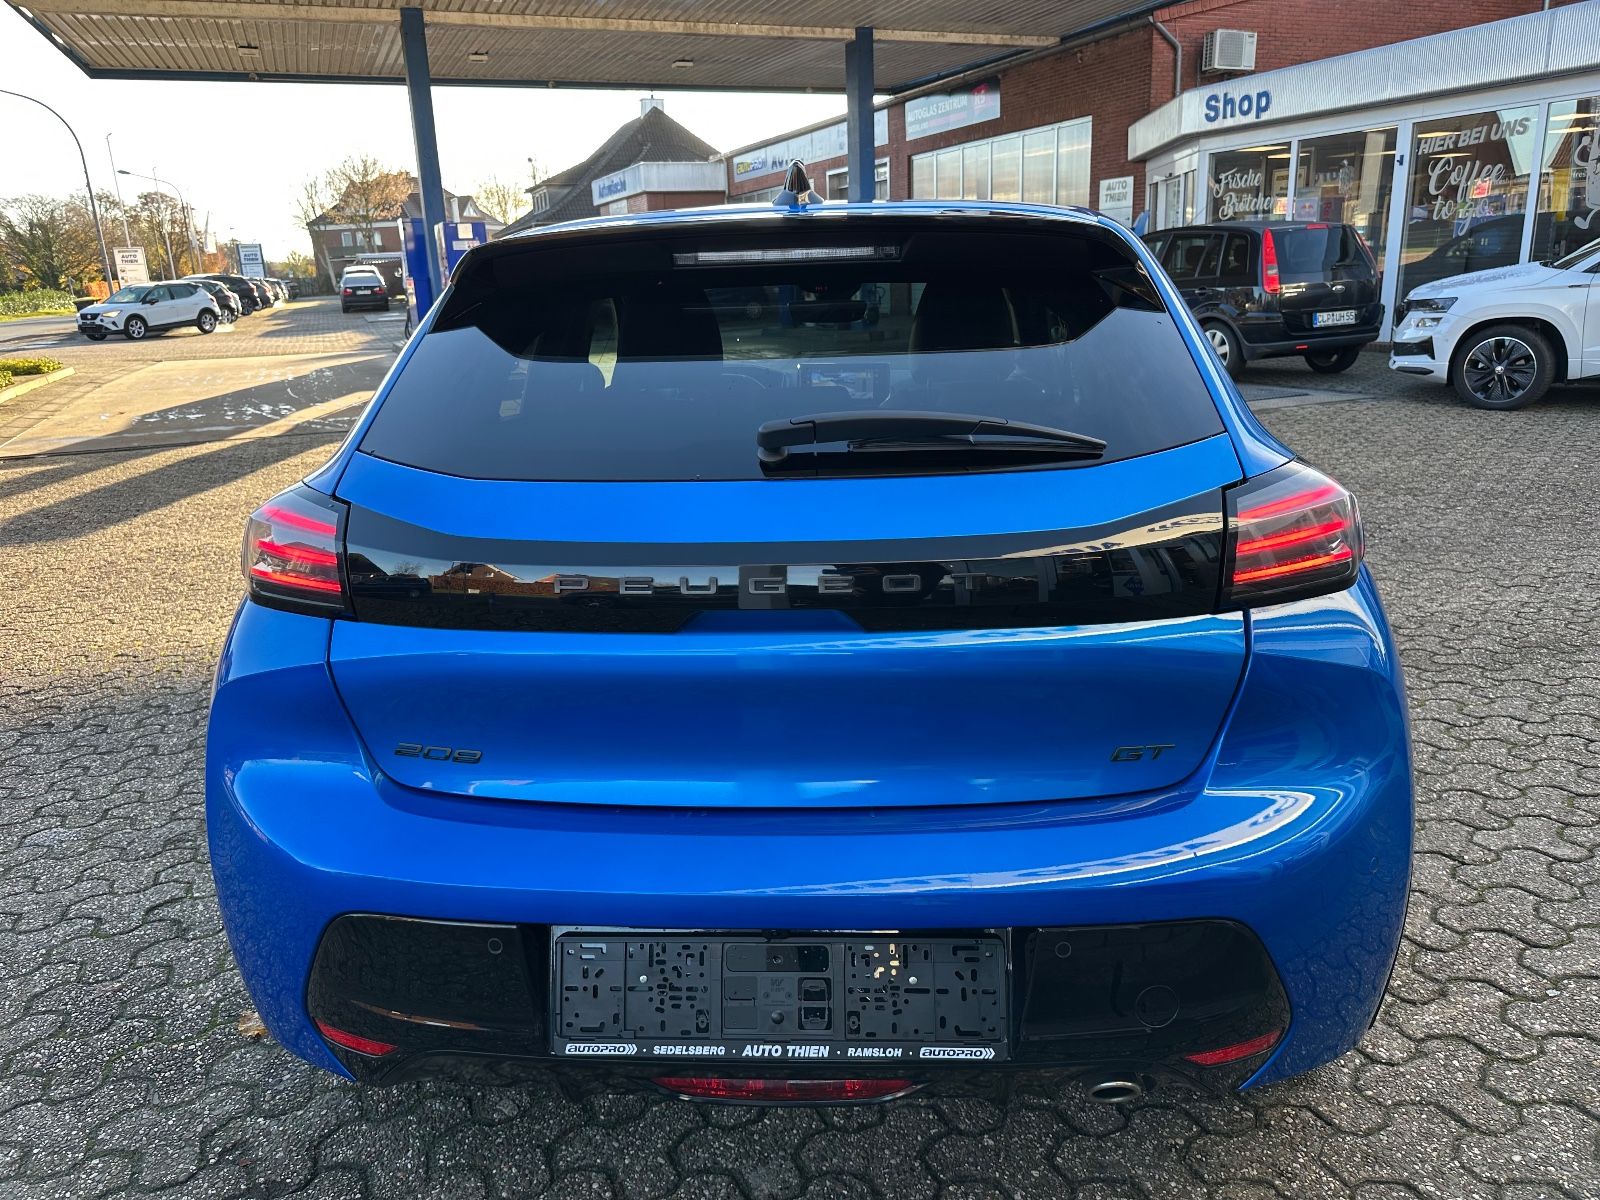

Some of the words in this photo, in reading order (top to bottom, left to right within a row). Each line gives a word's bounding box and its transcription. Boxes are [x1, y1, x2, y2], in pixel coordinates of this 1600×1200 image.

[938, 95, 968, 114] ZENTRUM
[1204, 89, 1272, 122] Shop
[1418, 137, 1456, 156] HIER
[1457, 125, 1488, 148] BEI
[1490, 117, 1531, 139] UNS
[1106, 180, 1127, 191] AUTO
[1213, 168, 1263, 197] Frische
[1428, 157, 1506, 202] Coffee
[1105, 192, 1127, 203] THIEN
[1432, 196, 1455, 220] to
[553, 572, 987, 596] PEUGEOT
[1110, 744, 1176, 762] GT
[653, 1045, 726, 1056] SEDELSBERG
[742, 1045, 782, 1057] AUTO
[786, 1045, 830, 1057] THIEN
[847, 1047, 903, 1057] RAMSLOH
